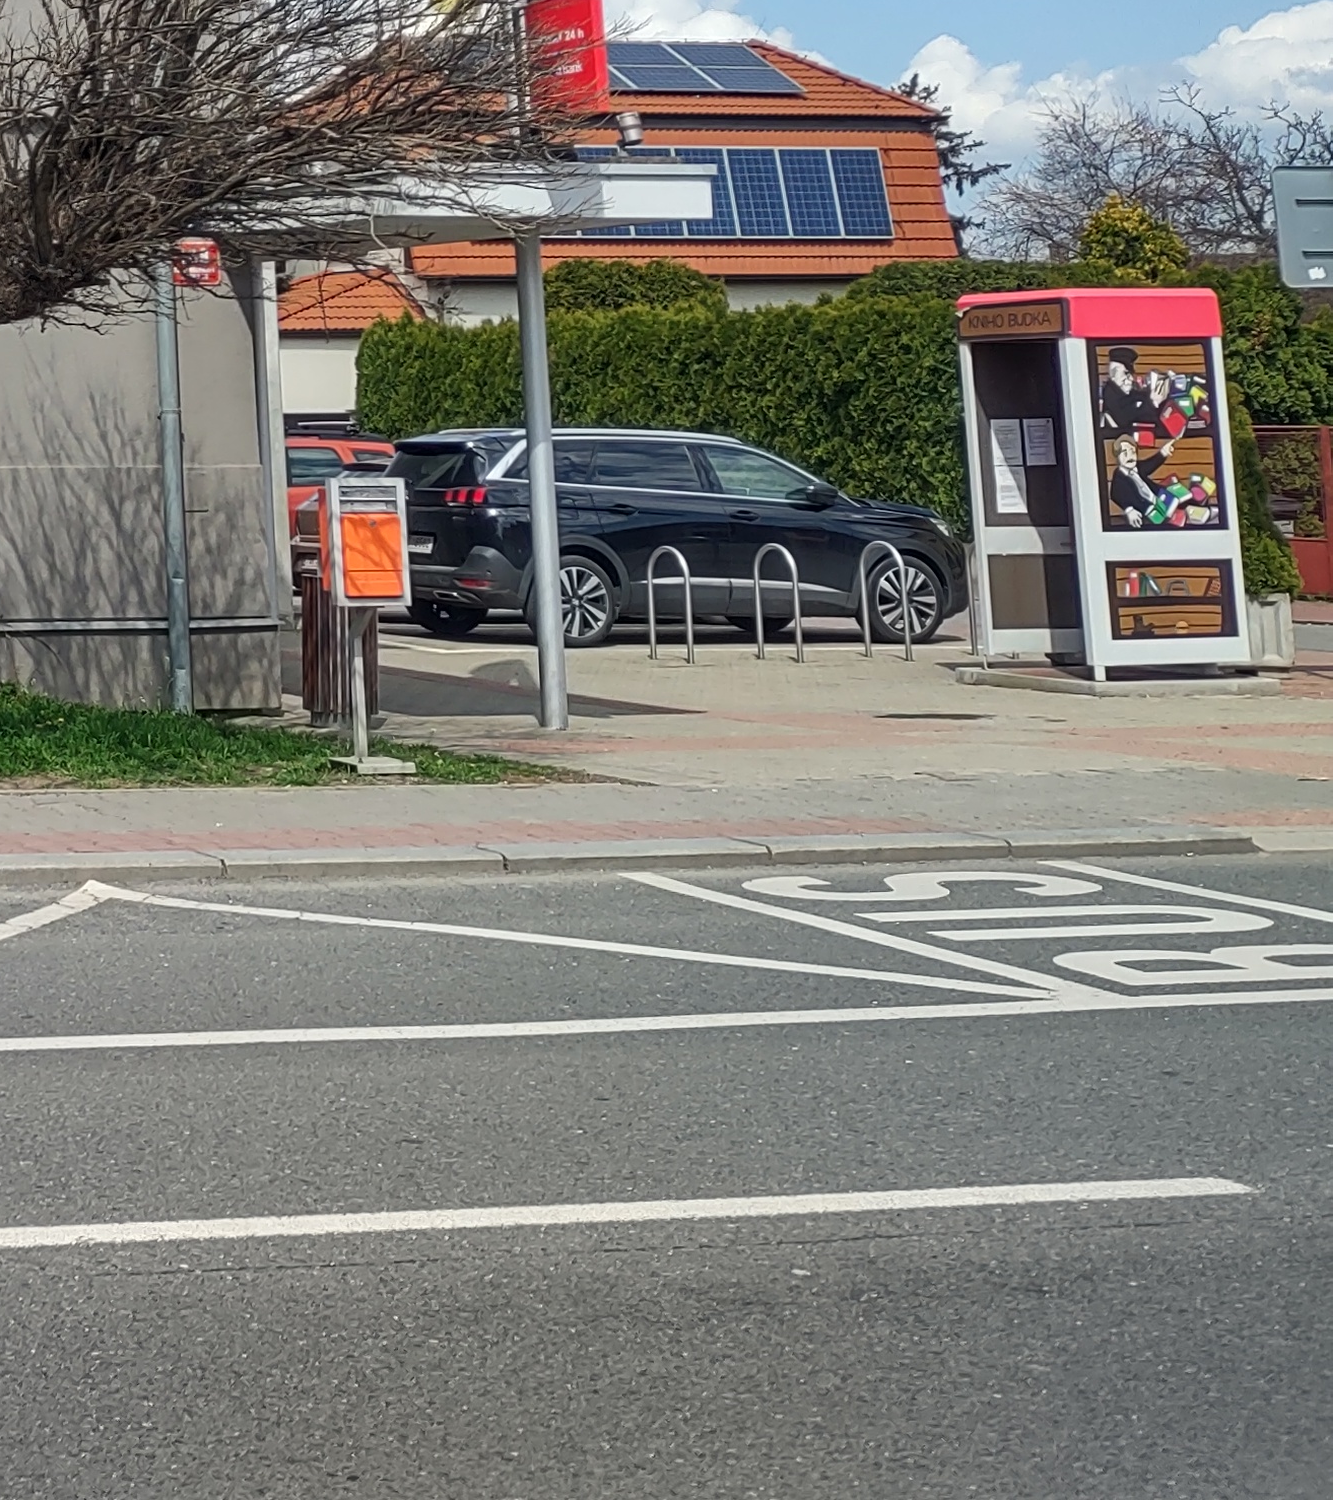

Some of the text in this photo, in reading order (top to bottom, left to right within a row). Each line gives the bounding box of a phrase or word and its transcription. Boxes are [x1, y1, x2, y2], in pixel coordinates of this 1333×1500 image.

[564, 28, 575, 41] 24
[968, 311, 1052, 329] KNIHO BUDKA
[741, 871, 1333, 986] BUS
